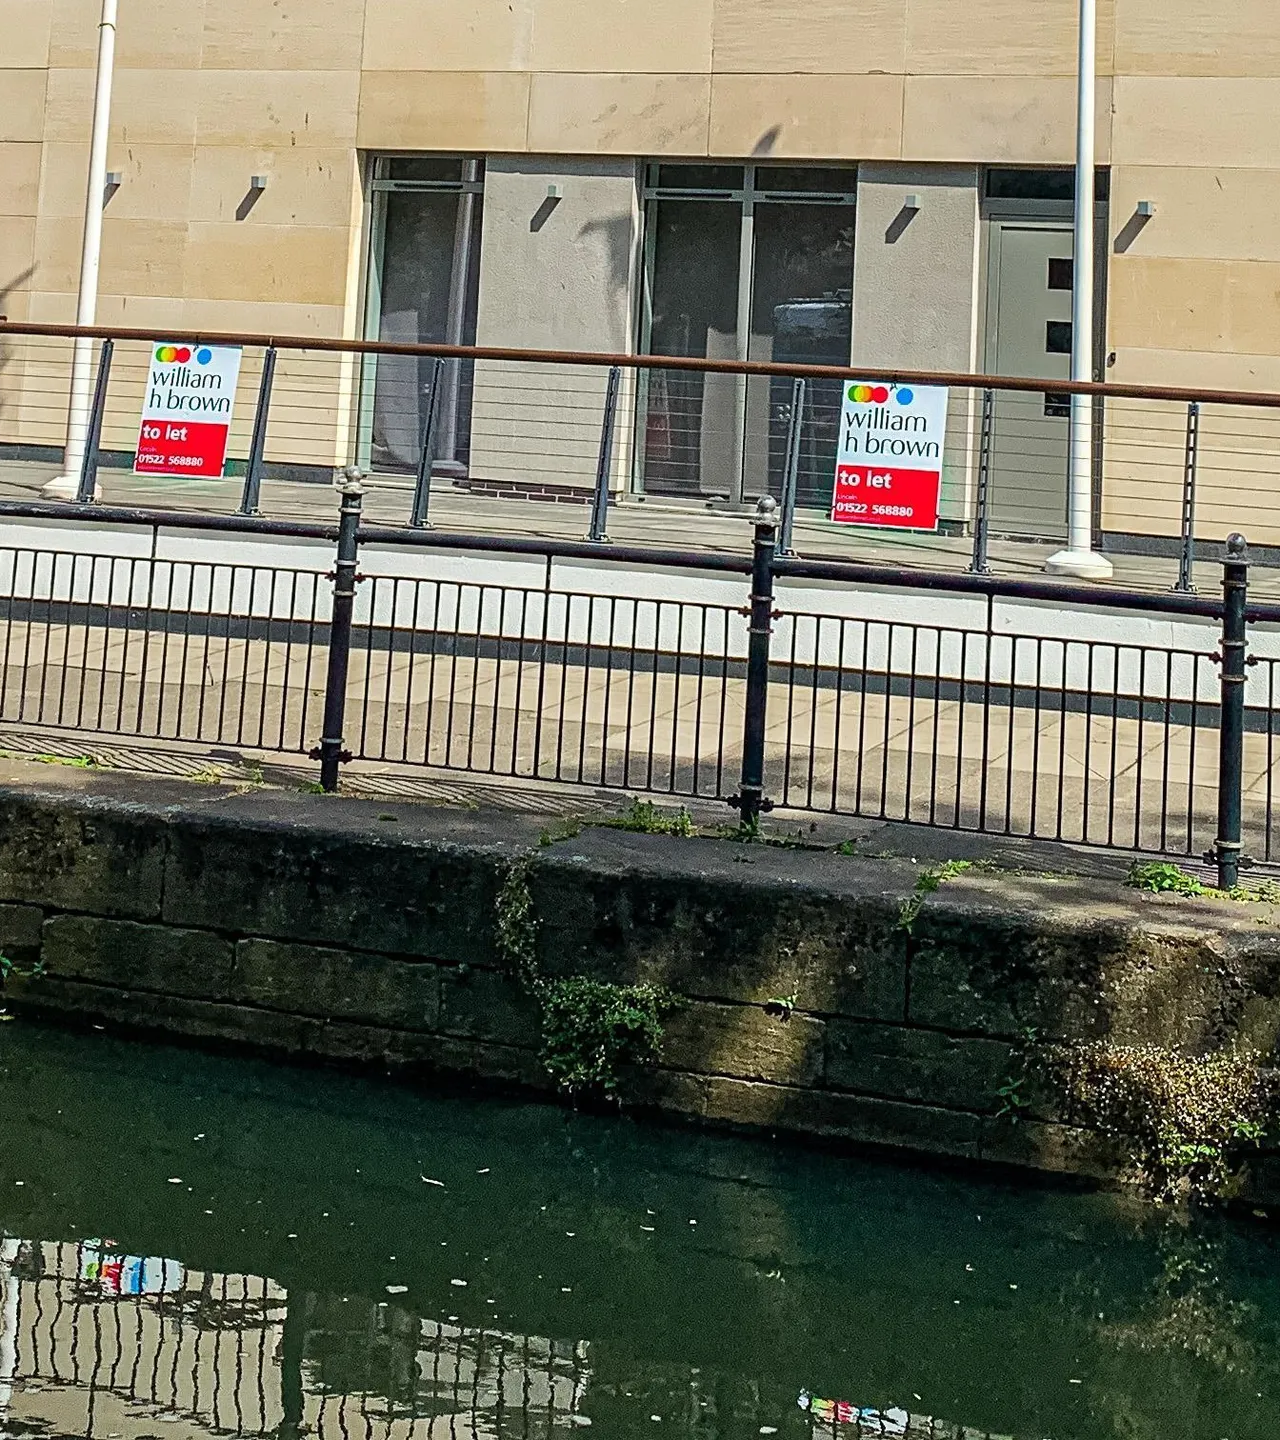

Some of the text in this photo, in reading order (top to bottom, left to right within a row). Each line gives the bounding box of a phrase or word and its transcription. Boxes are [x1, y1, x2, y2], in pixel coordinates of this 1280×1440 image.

[152, 366, 222, 389] william
[149, 388, 230, 413] h brown
[845, 407, 927, 432] william
[142, 424, 188, 442] to let
[845, 430, 940, 458] h brown
[138, 454, 204, 466] 01522 568880
[839, 470, 893, 489] to let
[836, 501, 914, 517] 01522 568880
